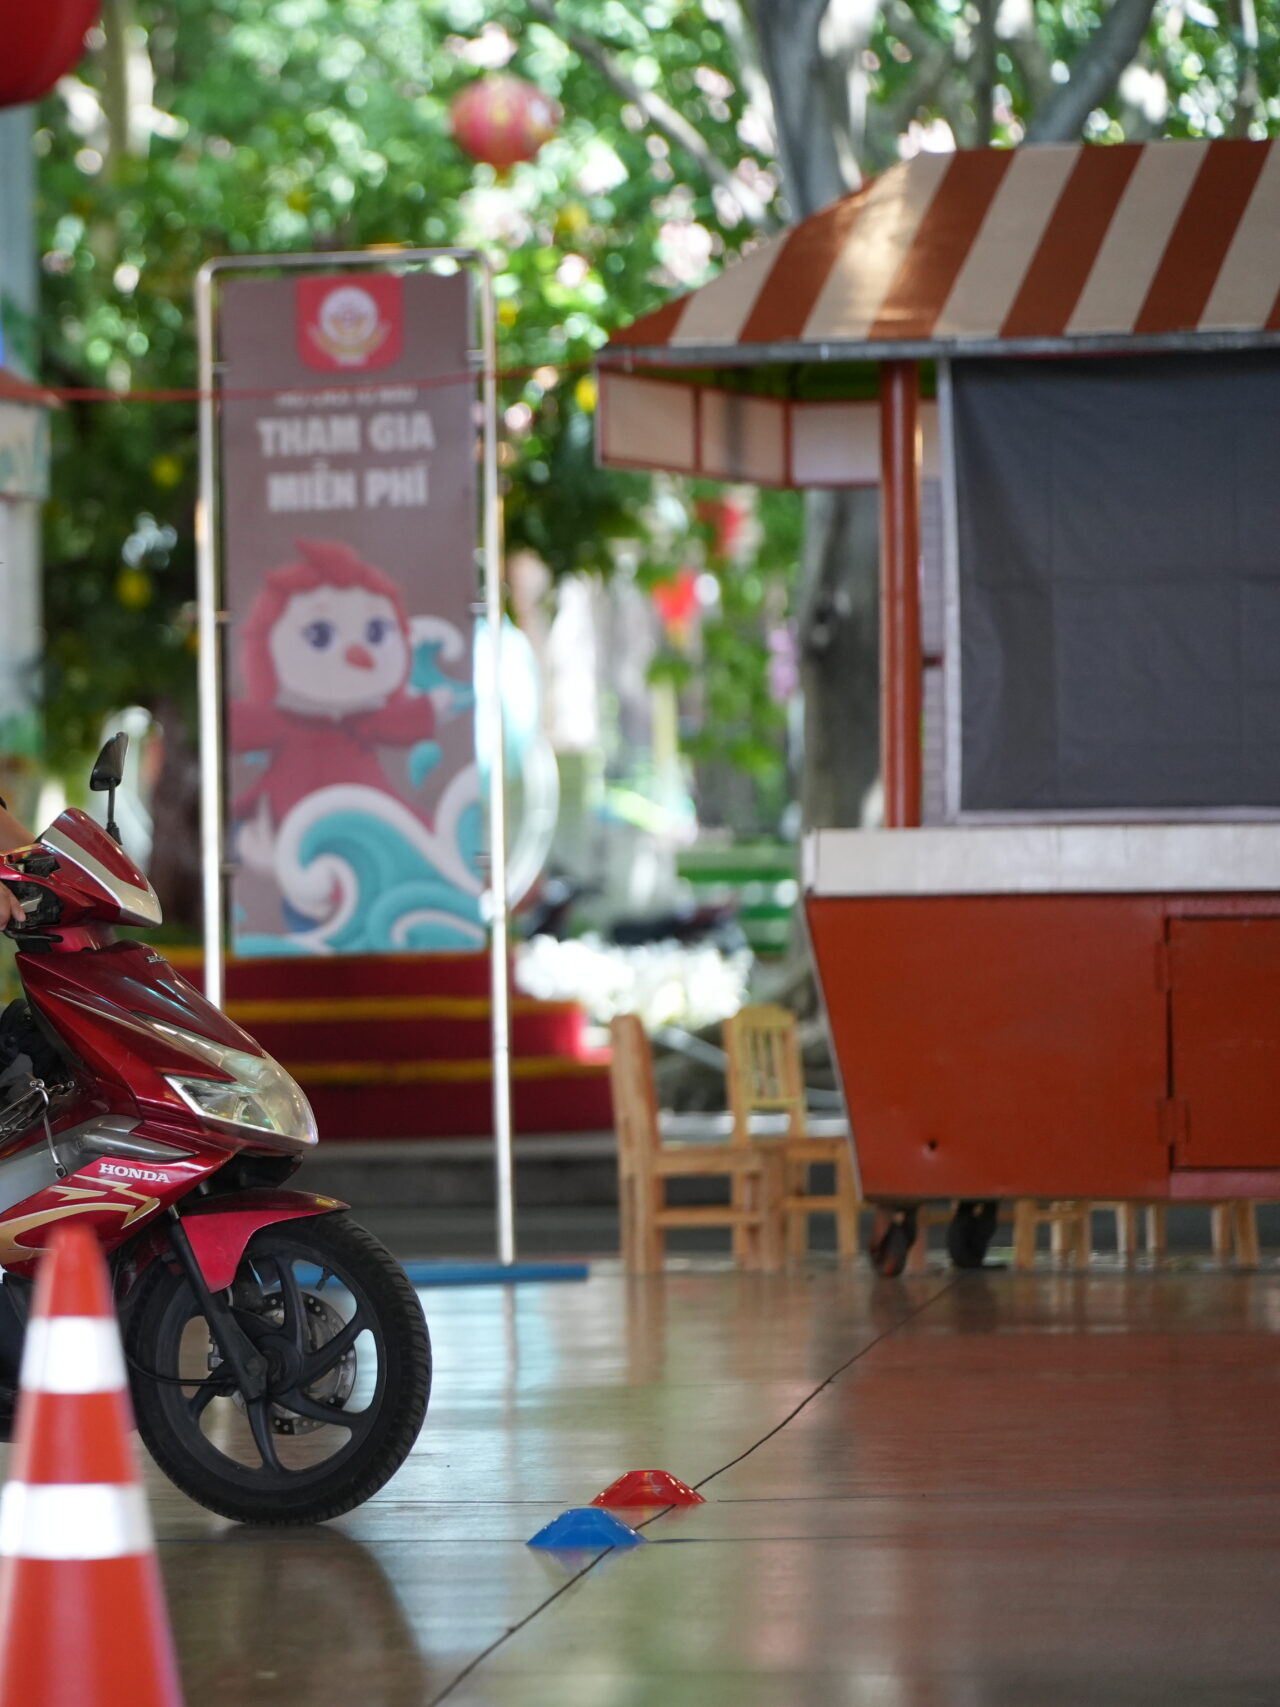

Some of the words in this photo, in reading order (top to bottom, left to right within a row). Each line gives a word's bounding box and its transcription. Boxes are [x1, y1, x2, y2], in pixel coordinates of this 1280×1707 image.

[257, 415, 360, 456] THAM
[368, 410, 437, 452] GIA
[99, 1163, 171, 1183] HONDA
